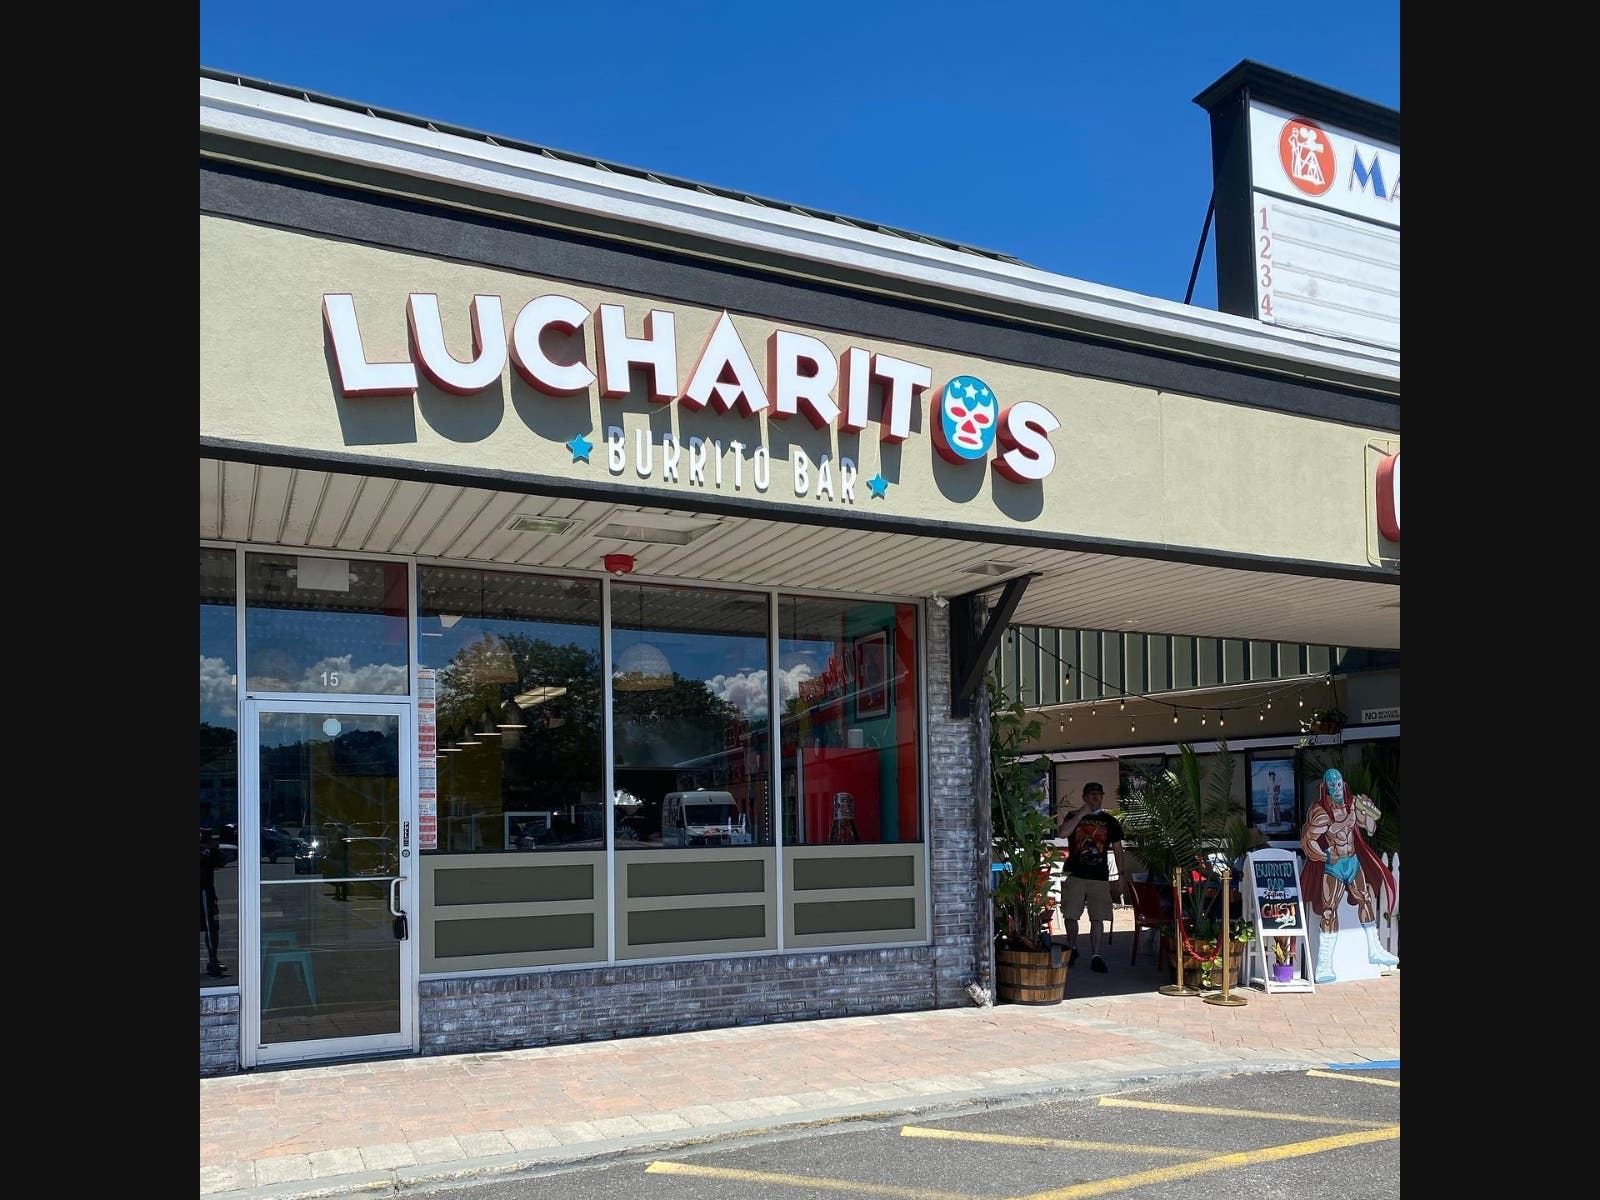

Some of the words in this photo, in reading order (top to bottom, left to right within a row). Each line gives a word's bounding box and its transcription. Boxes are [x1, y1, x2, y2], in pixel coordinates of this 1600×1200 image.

[1348, 144, 1400, 202] M
[1260, 207, 1269, 231] 1
[1260, 235, 1271, 259] 2
[1260, 264, 1271, 288] 3
[1261, 293, 1272, 317] 4
[608, 425, 770, 493] BURRITO
[794, 449, 857, 503] BAR
[320, 671, 339, 687] 15
[1364, 712, 1377, 720] NO
[1255, 863, 1292, 877] BURRITO
